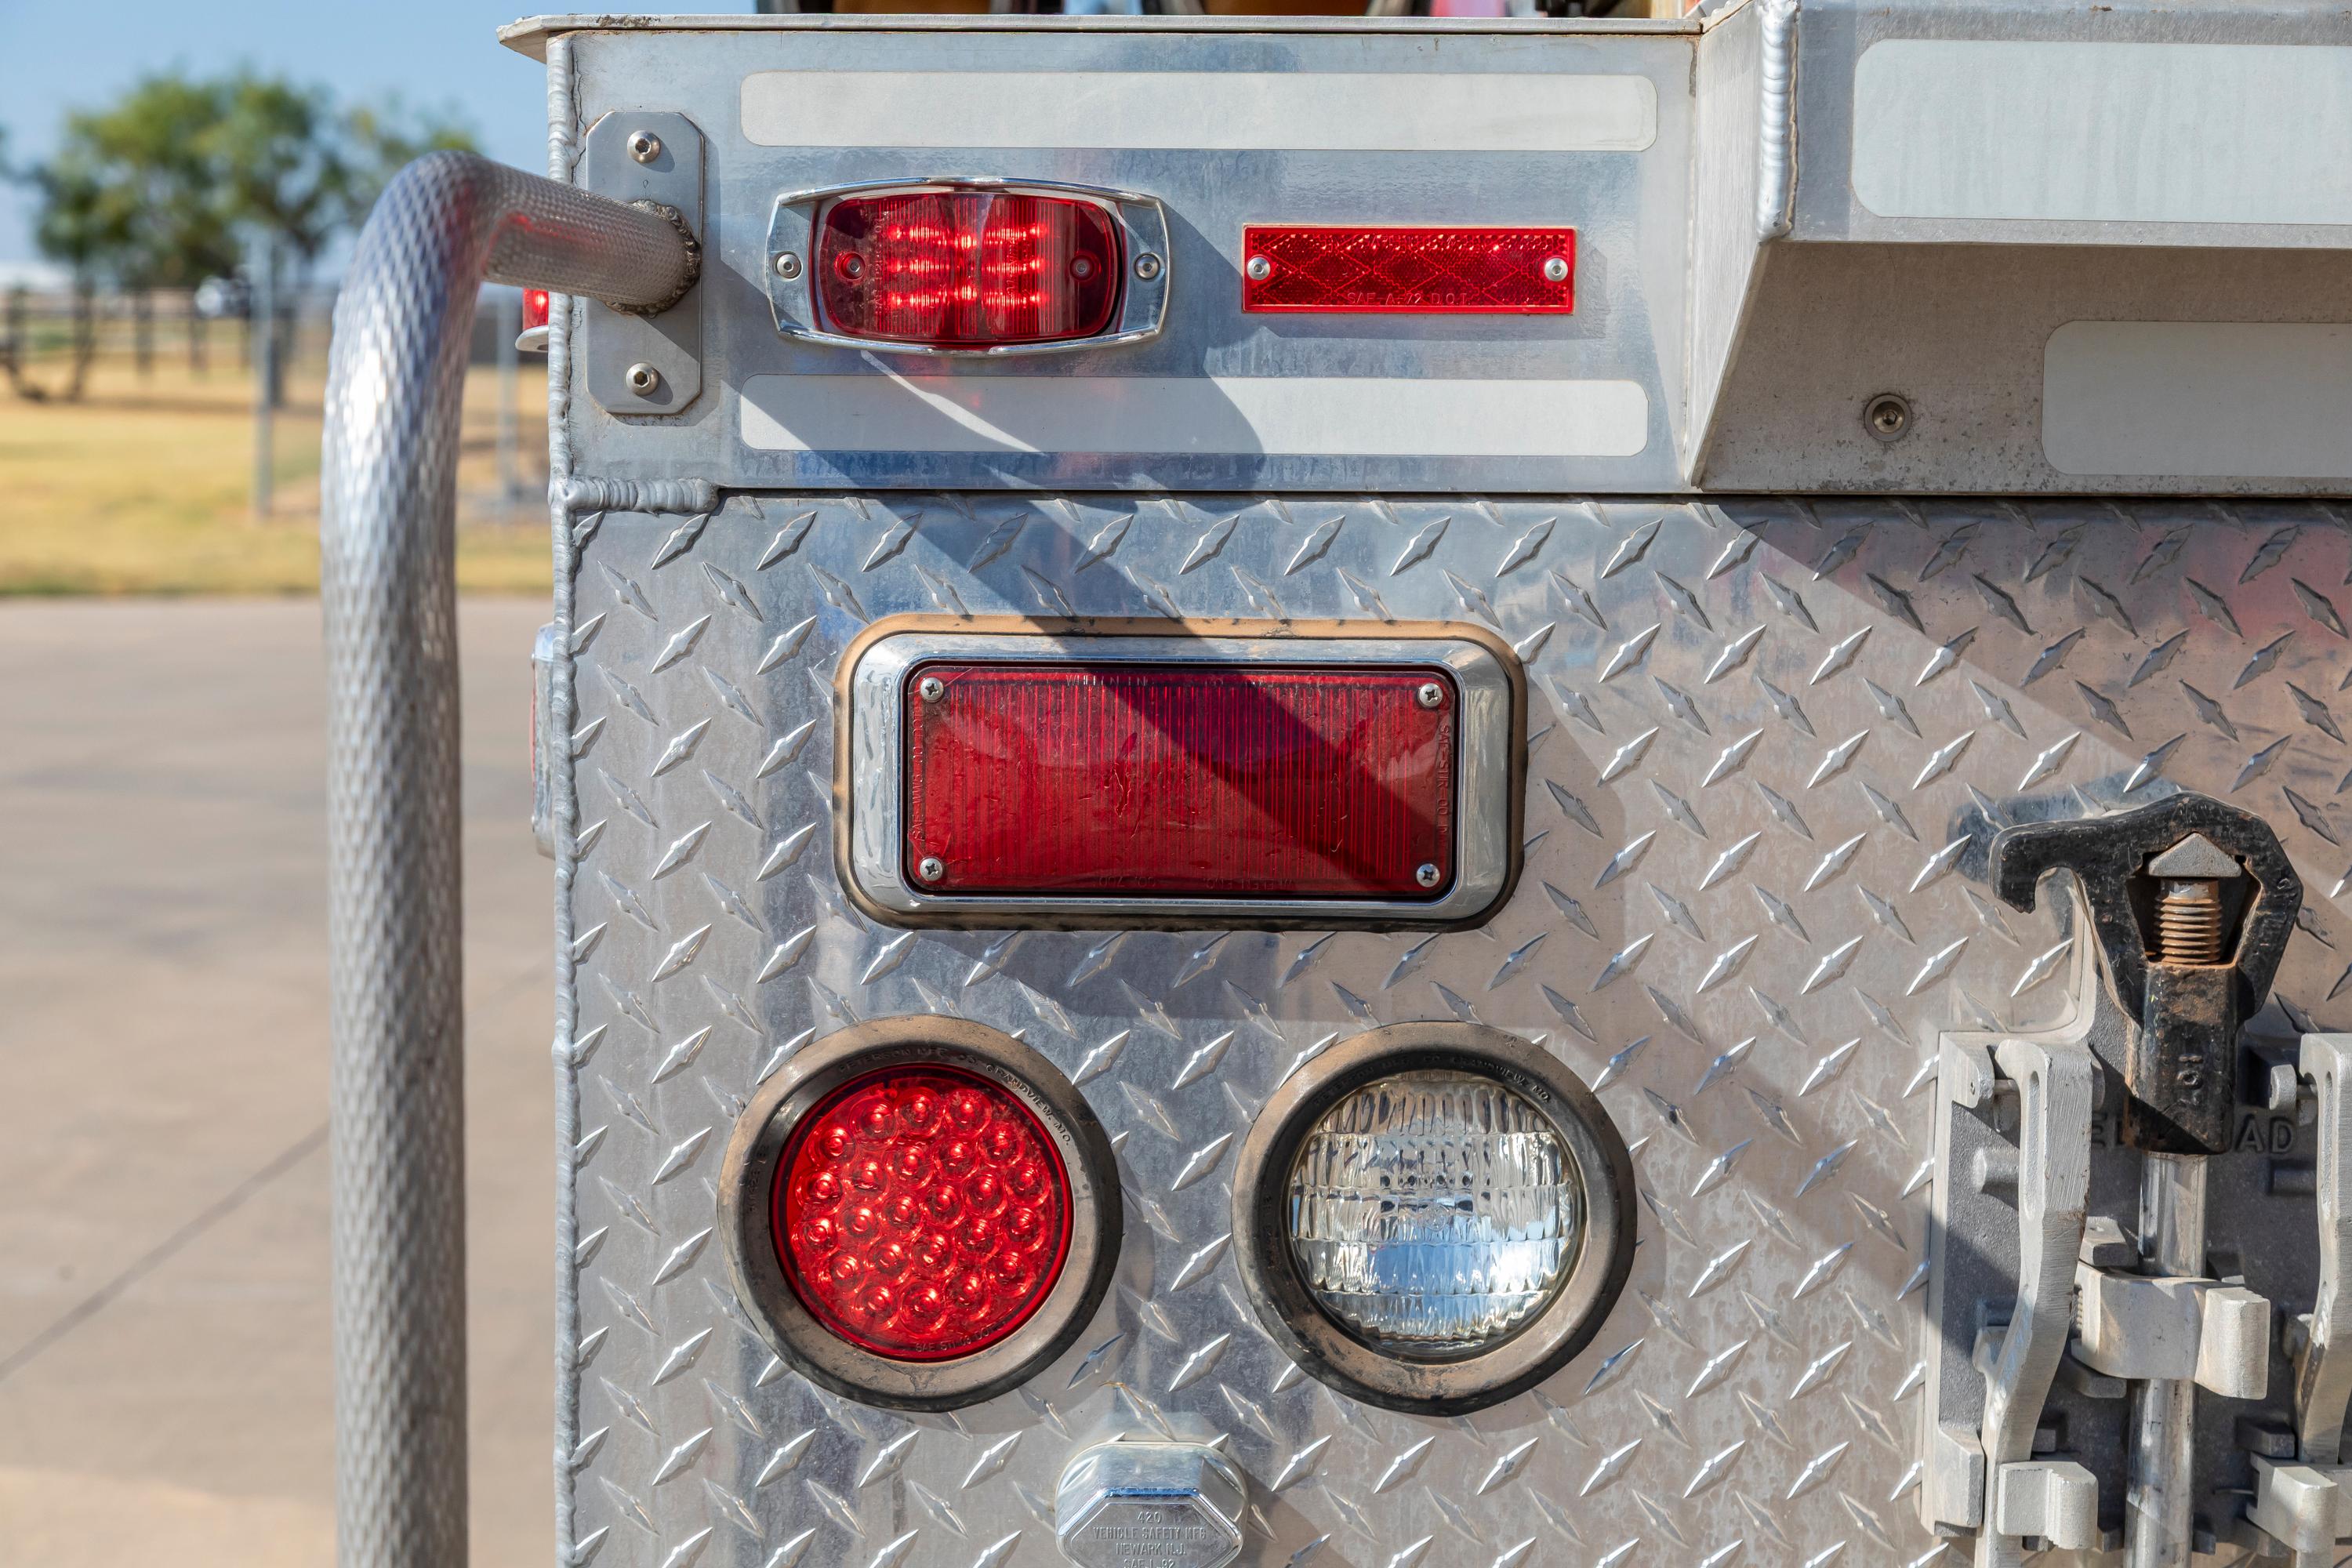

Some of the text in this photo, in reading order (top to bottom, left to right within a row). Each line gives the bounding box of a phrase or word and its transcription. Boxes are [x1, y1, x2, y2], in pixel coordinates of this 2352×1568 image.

[1137, 1511, 1163, 1524] 420
[1093, 1526, 1207, 1540] VEHICLE SAFETY MFG
[1116, 1542, 1187, 1556] NEWARK N.J.
